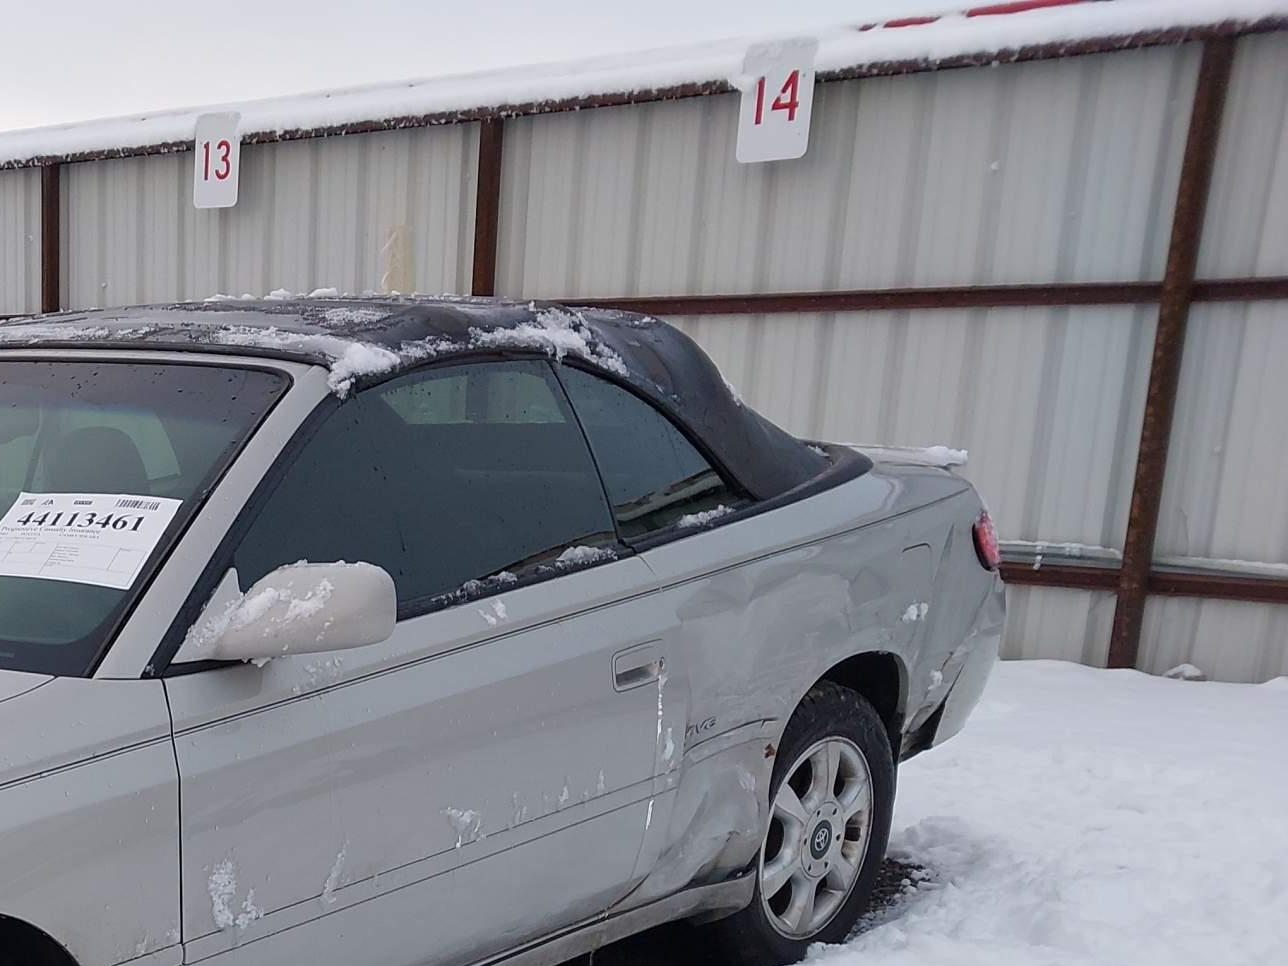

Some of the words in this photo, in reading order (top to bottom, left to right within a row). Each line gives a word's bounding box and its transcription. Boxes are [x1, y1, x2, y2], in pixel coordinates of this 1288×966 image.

[753, 69, 801, 125] 14
[201, 139, 232, 182] 13
[17, 510, 146, 532] 44113461
